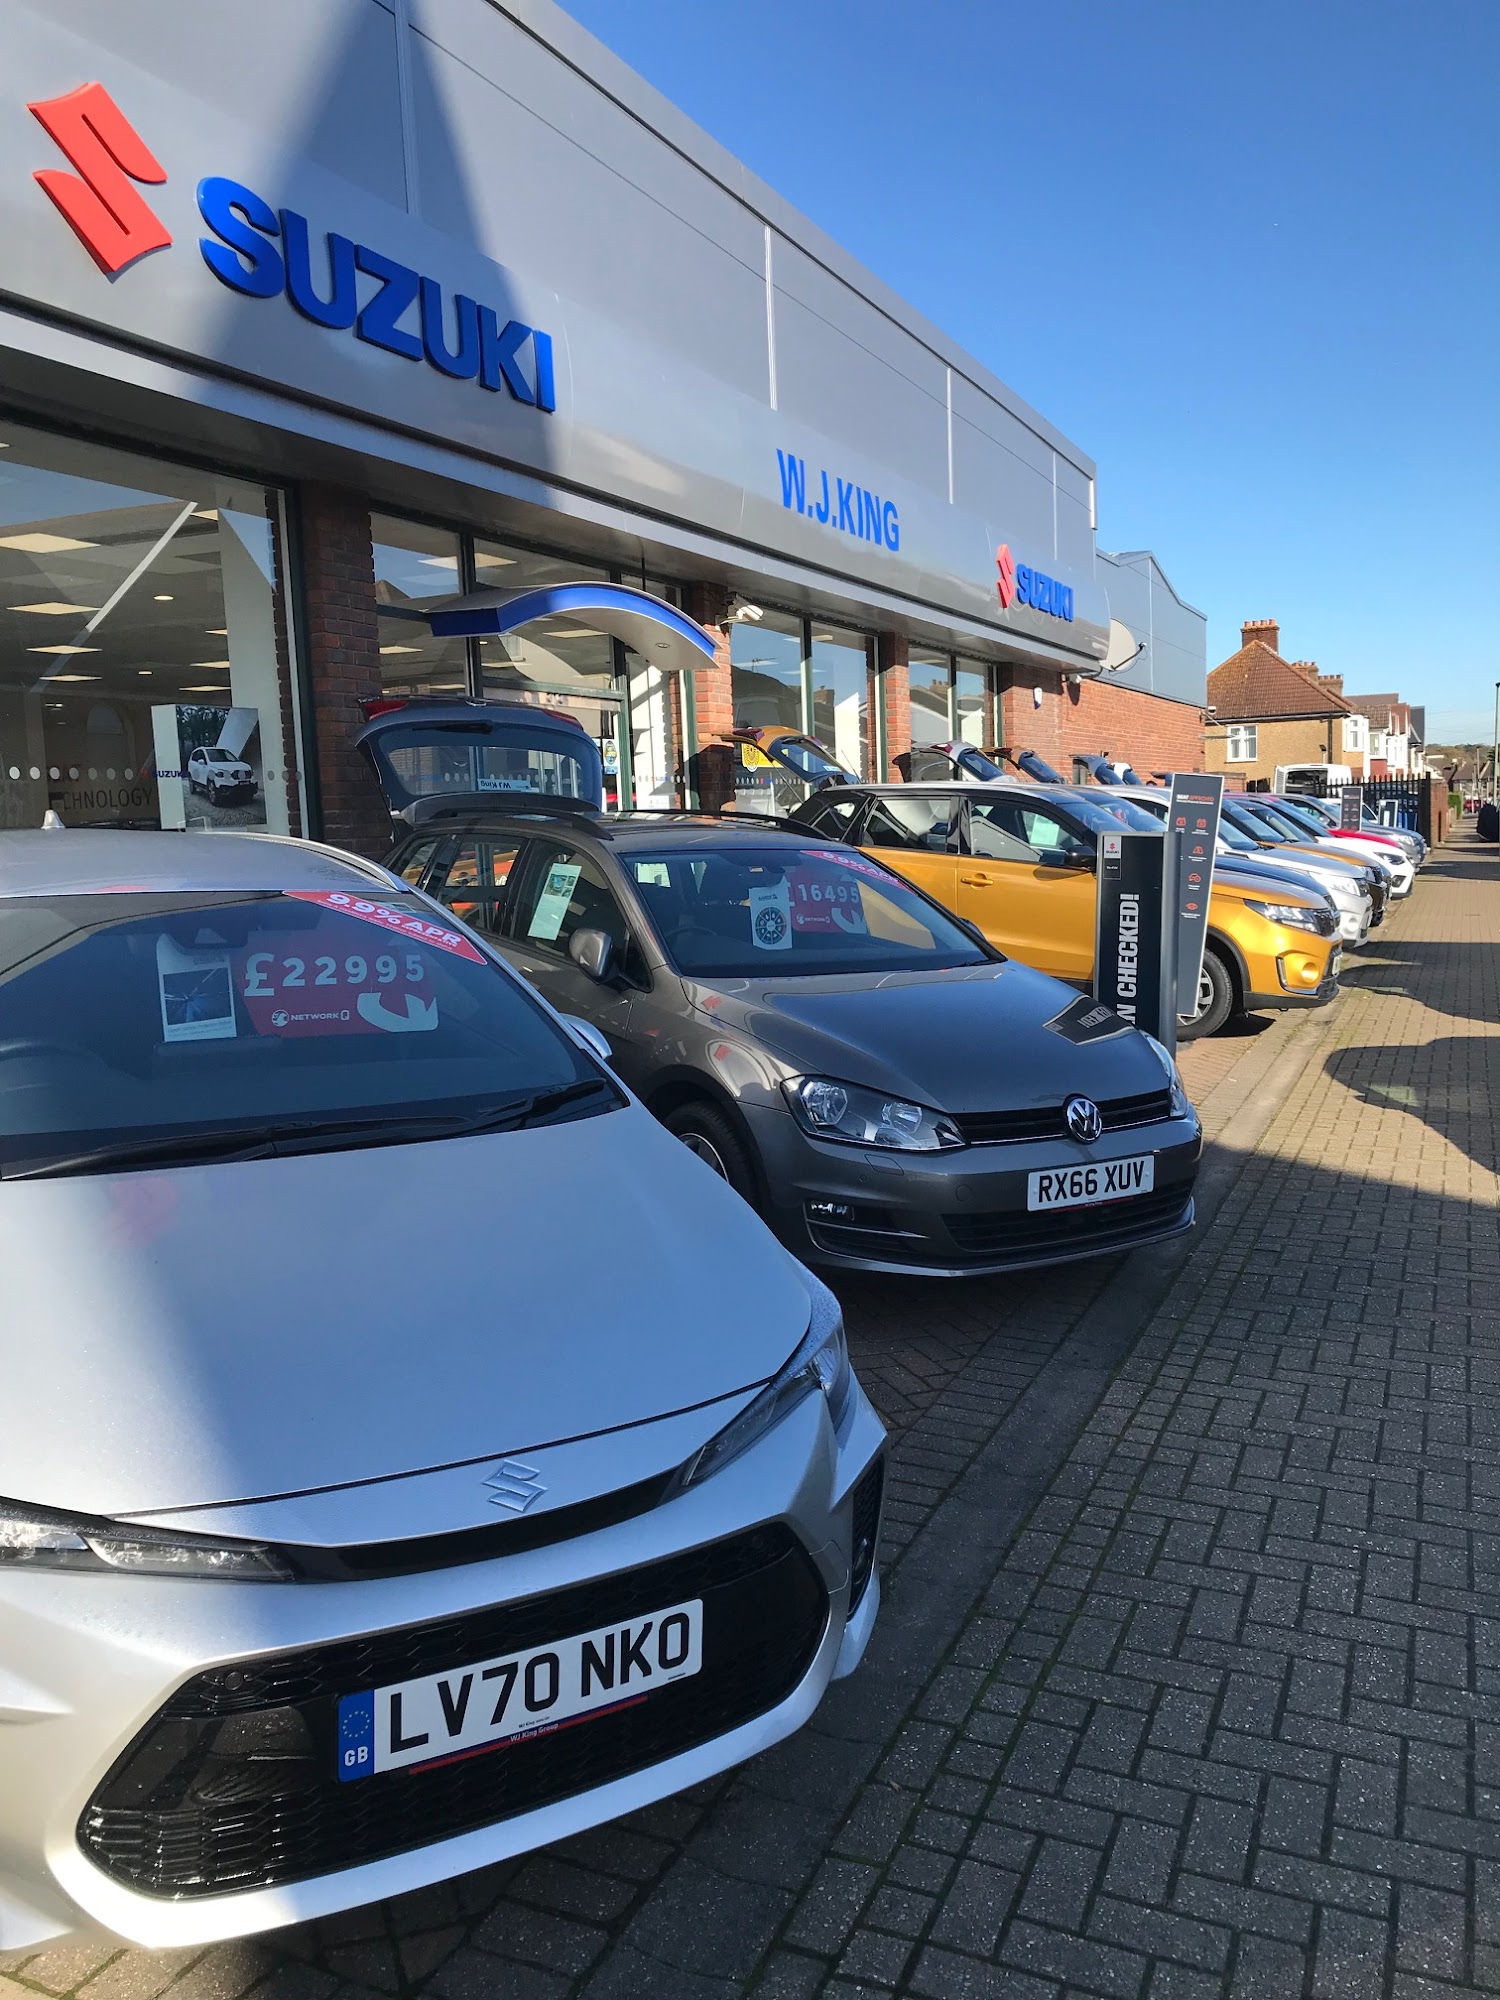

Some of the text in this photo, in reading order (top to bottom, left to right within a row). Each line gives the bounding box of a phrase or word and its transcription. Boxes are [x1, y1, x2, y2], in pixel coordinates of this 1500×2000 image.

[197, 177, 556, 413] SUZUKI
[776, 448, 900, 552] W.J.KING
[1017, 563, 1075, 623] SUZUKI
[50, 787, 153, 811] CHNOLOGY
[795, 882, 860, 904] 16495
[326, 893, 402, 925] 9.9%
[403, 921, 461, 947] APR
[1116, 893, 1140, 998] CHECKED!
[244, 952, 424, 997] £22995
[290, 1012, 340, 1021] NETWORK
[1038, 1160, 1145, 1203] RX66 XUV
[390, 1612, 690, 1754] LV70 NKO
[522, 1729, 538, 1738] King
[538, 1723, 559, 1733] Group
[344, 1746, 368, 1767] GB
